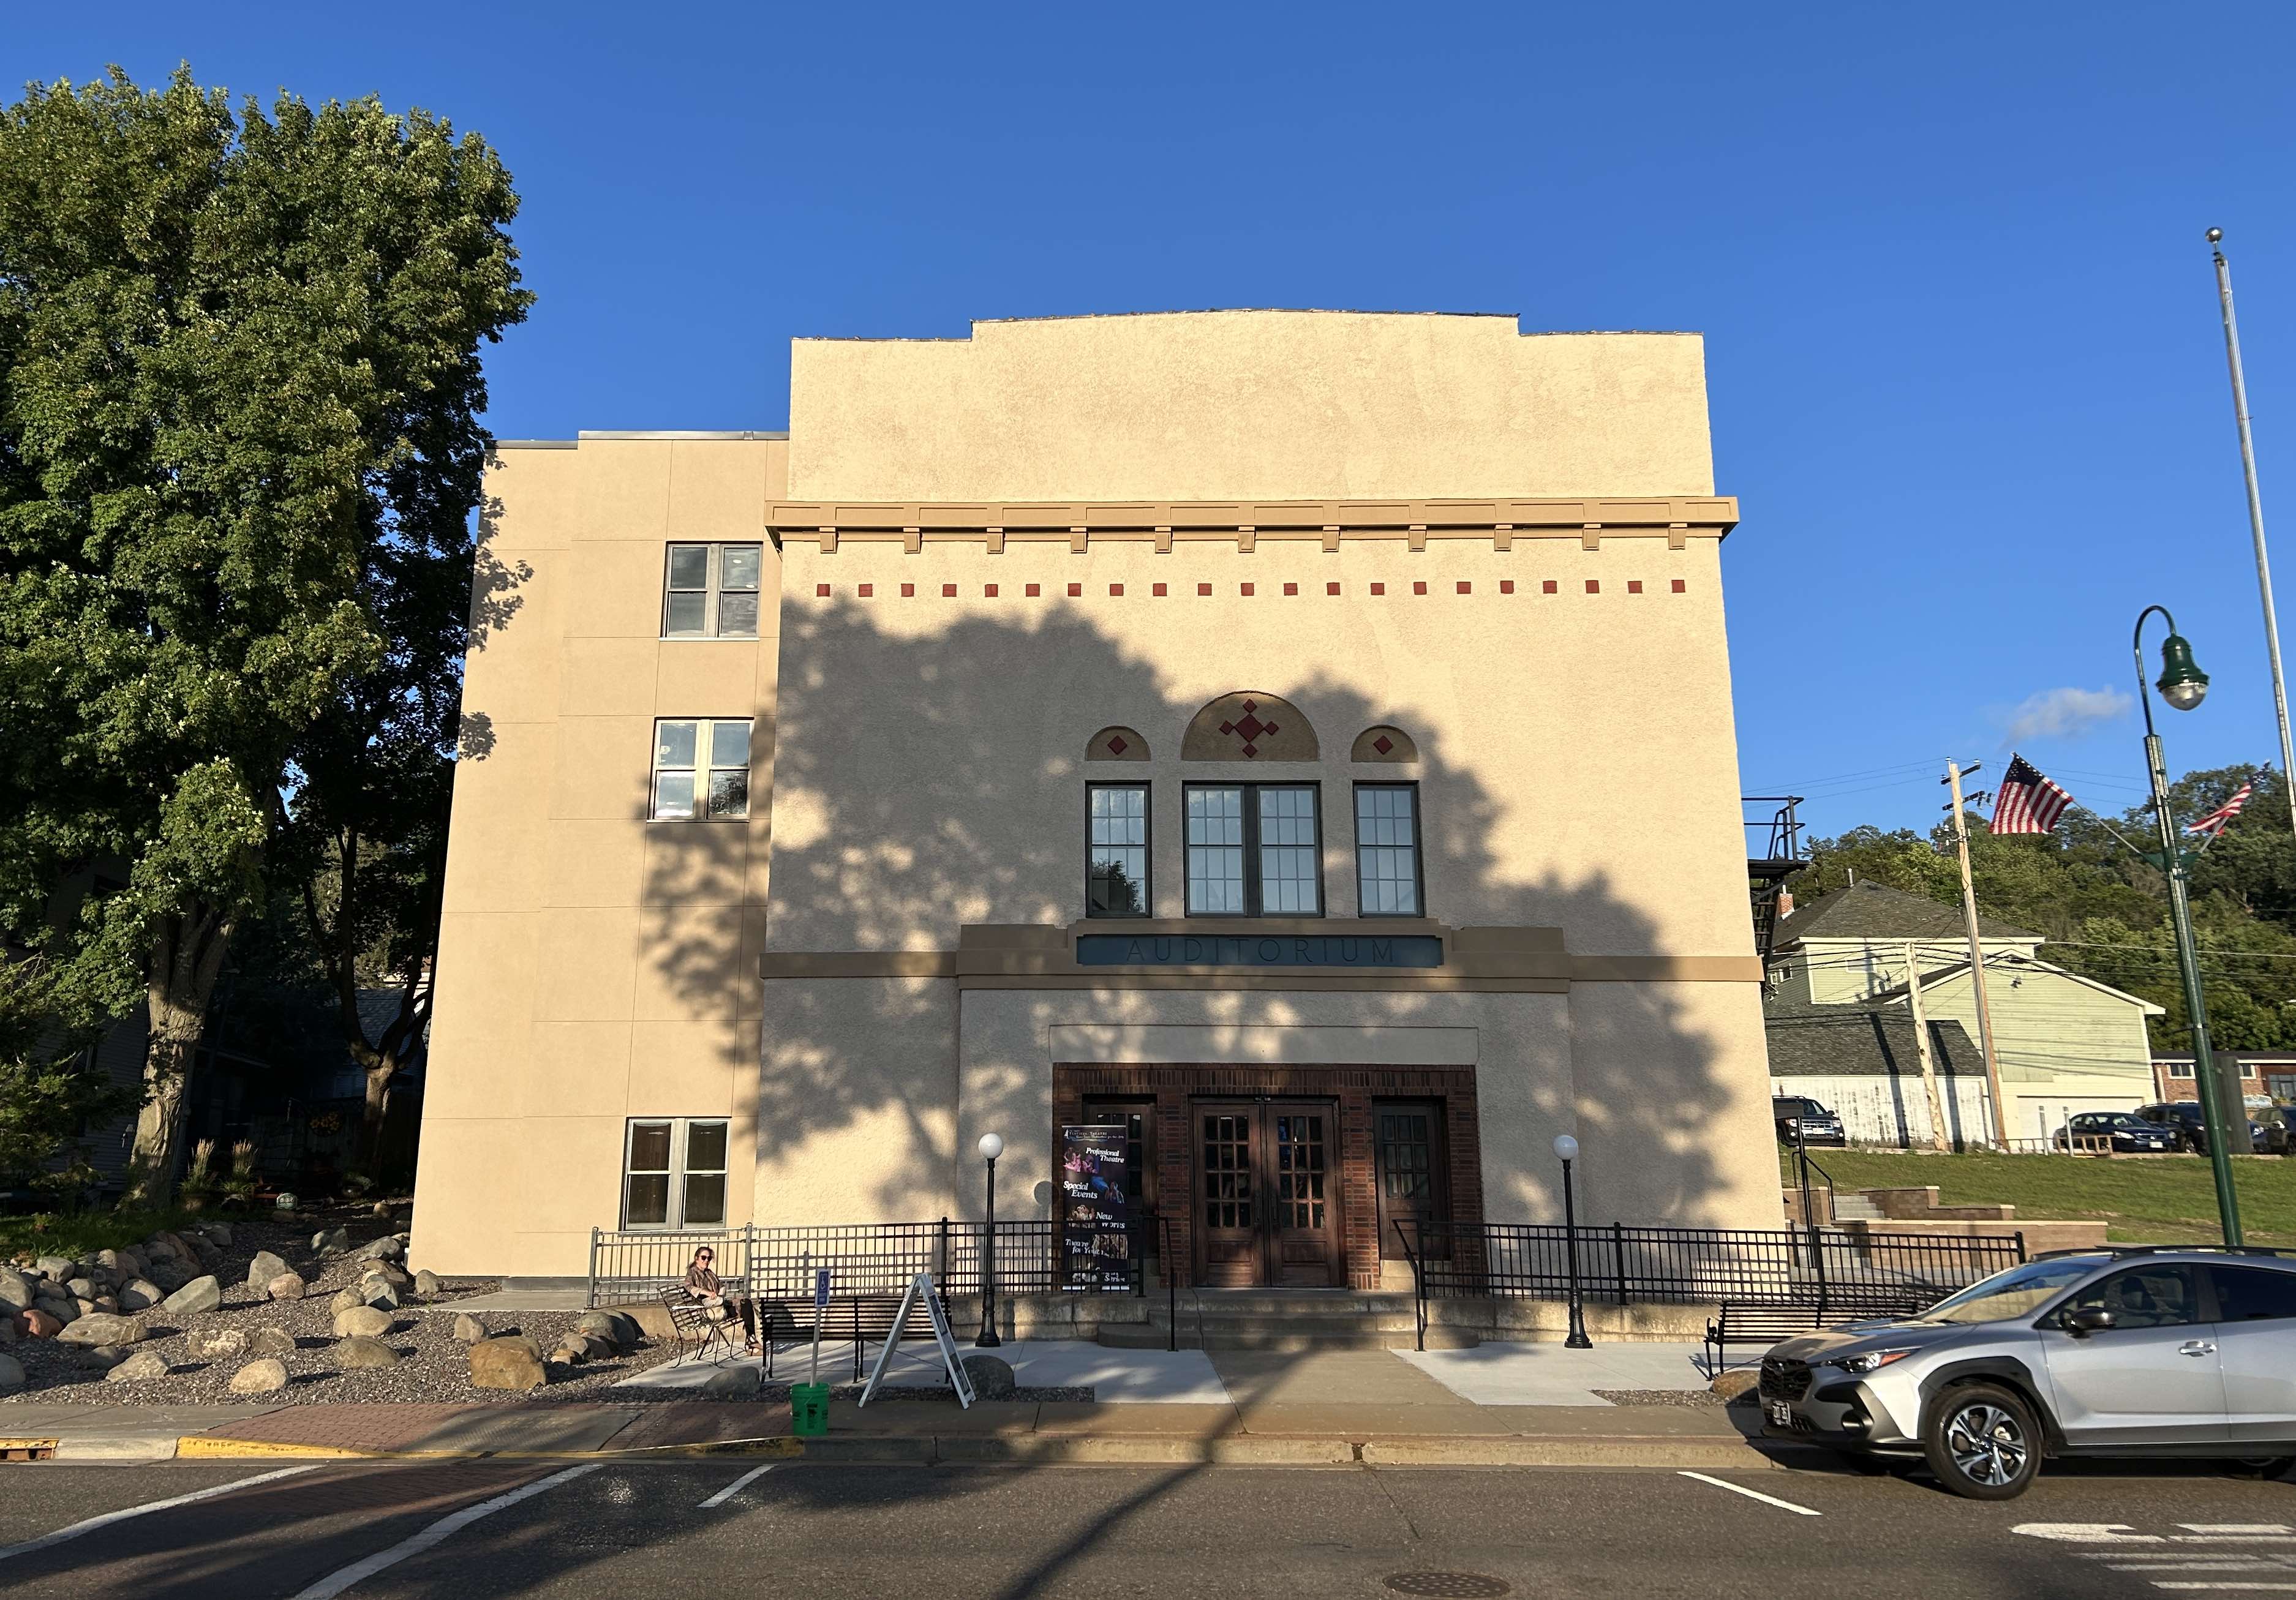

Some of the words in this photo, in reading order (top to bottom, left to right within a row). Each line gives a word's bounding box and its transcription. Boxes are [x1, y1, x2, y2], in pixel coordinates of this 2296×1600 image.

[1126, 937, 1394, 963] AUDITORIUM
[1085, 1147, 1120, 1157] Professional
[1100, 1154, 1125, 1163] Theatre
[1063, 1180, 1089, 1191] Special
[1071, 1189, 1098, 1199] Events
[1095, 1211, 1113, 1220] New
[1065, 1238, 1090, 1247] Theare
